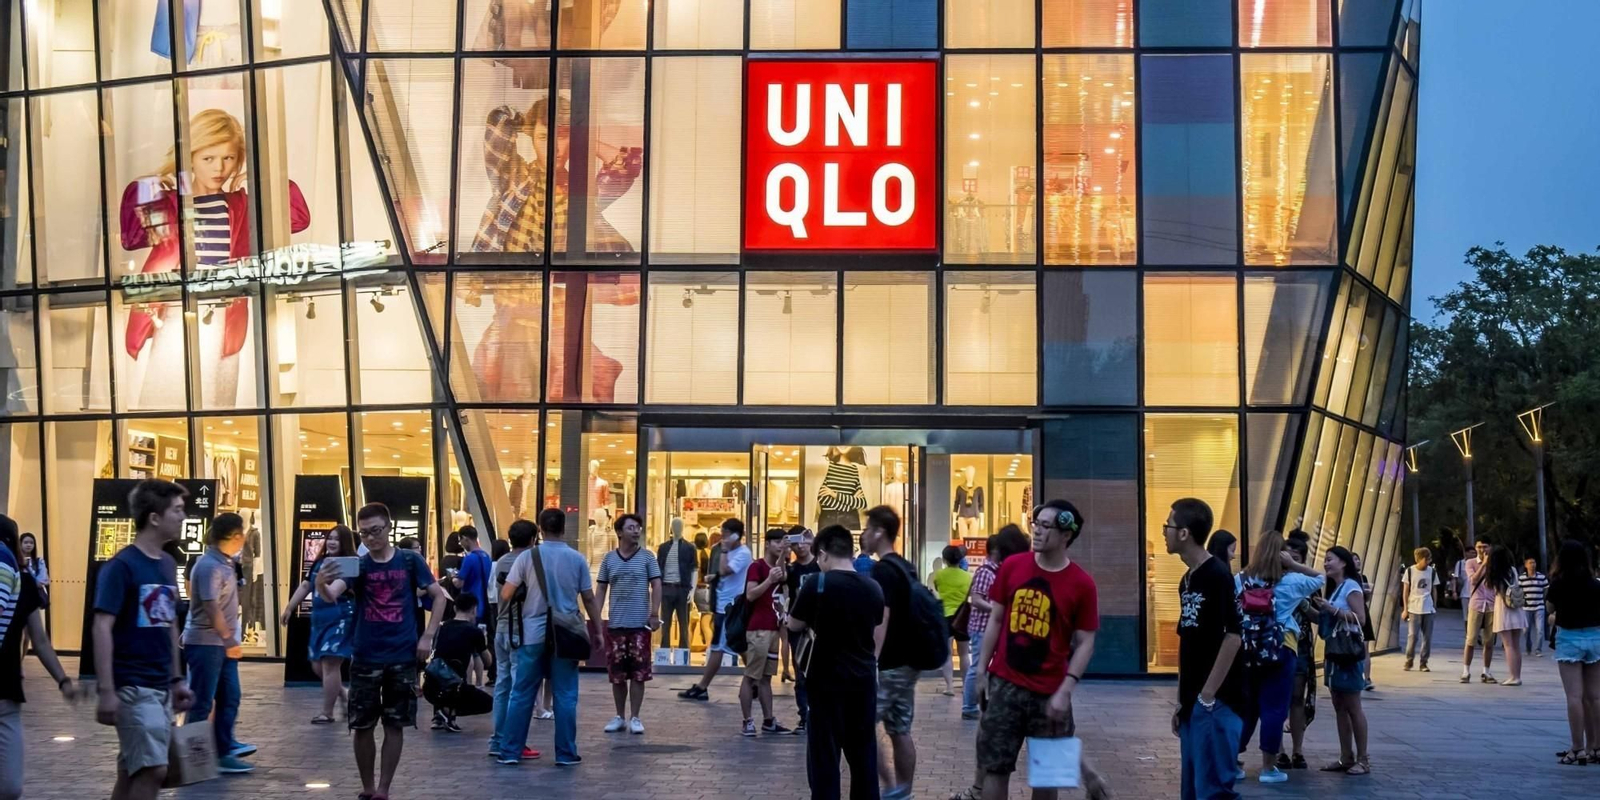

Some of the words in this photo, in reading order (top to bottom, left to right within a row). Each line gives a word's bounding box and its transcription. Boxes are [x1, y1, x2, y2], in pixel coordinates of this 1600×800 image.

[767, 83, 902, 147] UNI
[765, 162, 916, 239] QLO
[159, 462, 182, 478] ARRIVAL
[965, 540, 977, 550] UT
